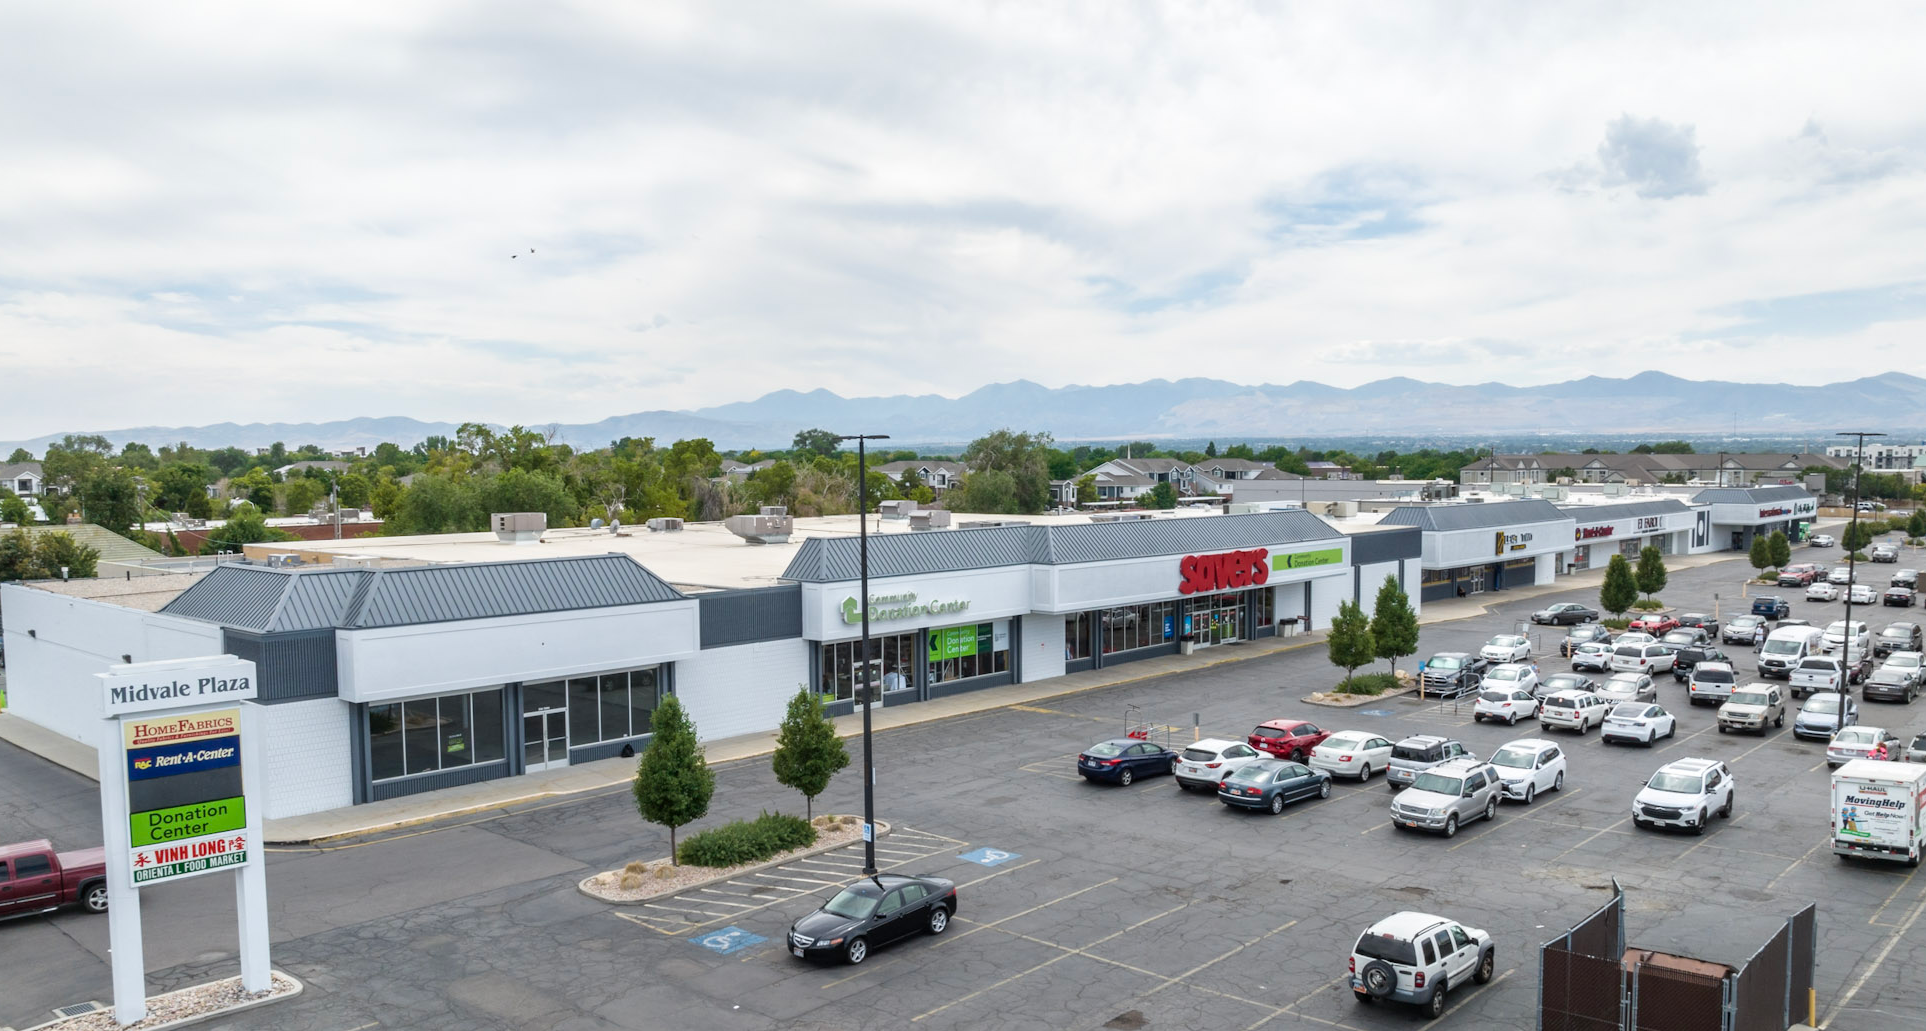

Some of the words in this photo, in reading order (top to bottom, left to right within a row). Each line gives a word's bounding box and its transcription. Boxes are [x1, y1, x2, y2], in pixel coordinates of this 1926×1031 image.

[868, 602, 928, 622] Donation
[929, 599, 971, 615] Center
[110, 681, 190, 704] Midvale
[198, 676, 250, 695] Plaza
[134, 760, 152, 770] RAC
[149, 805, 228, 826] Donation
[1876, 811, 1890, 819] Help
[150, 822, 209, 840] Center
[154, 845, 188, 864] VINH
[192, 839, 226, 858] LONG
[184, 859, 207, 873] FOOD
[209, 852, 244, 868] MARKET
